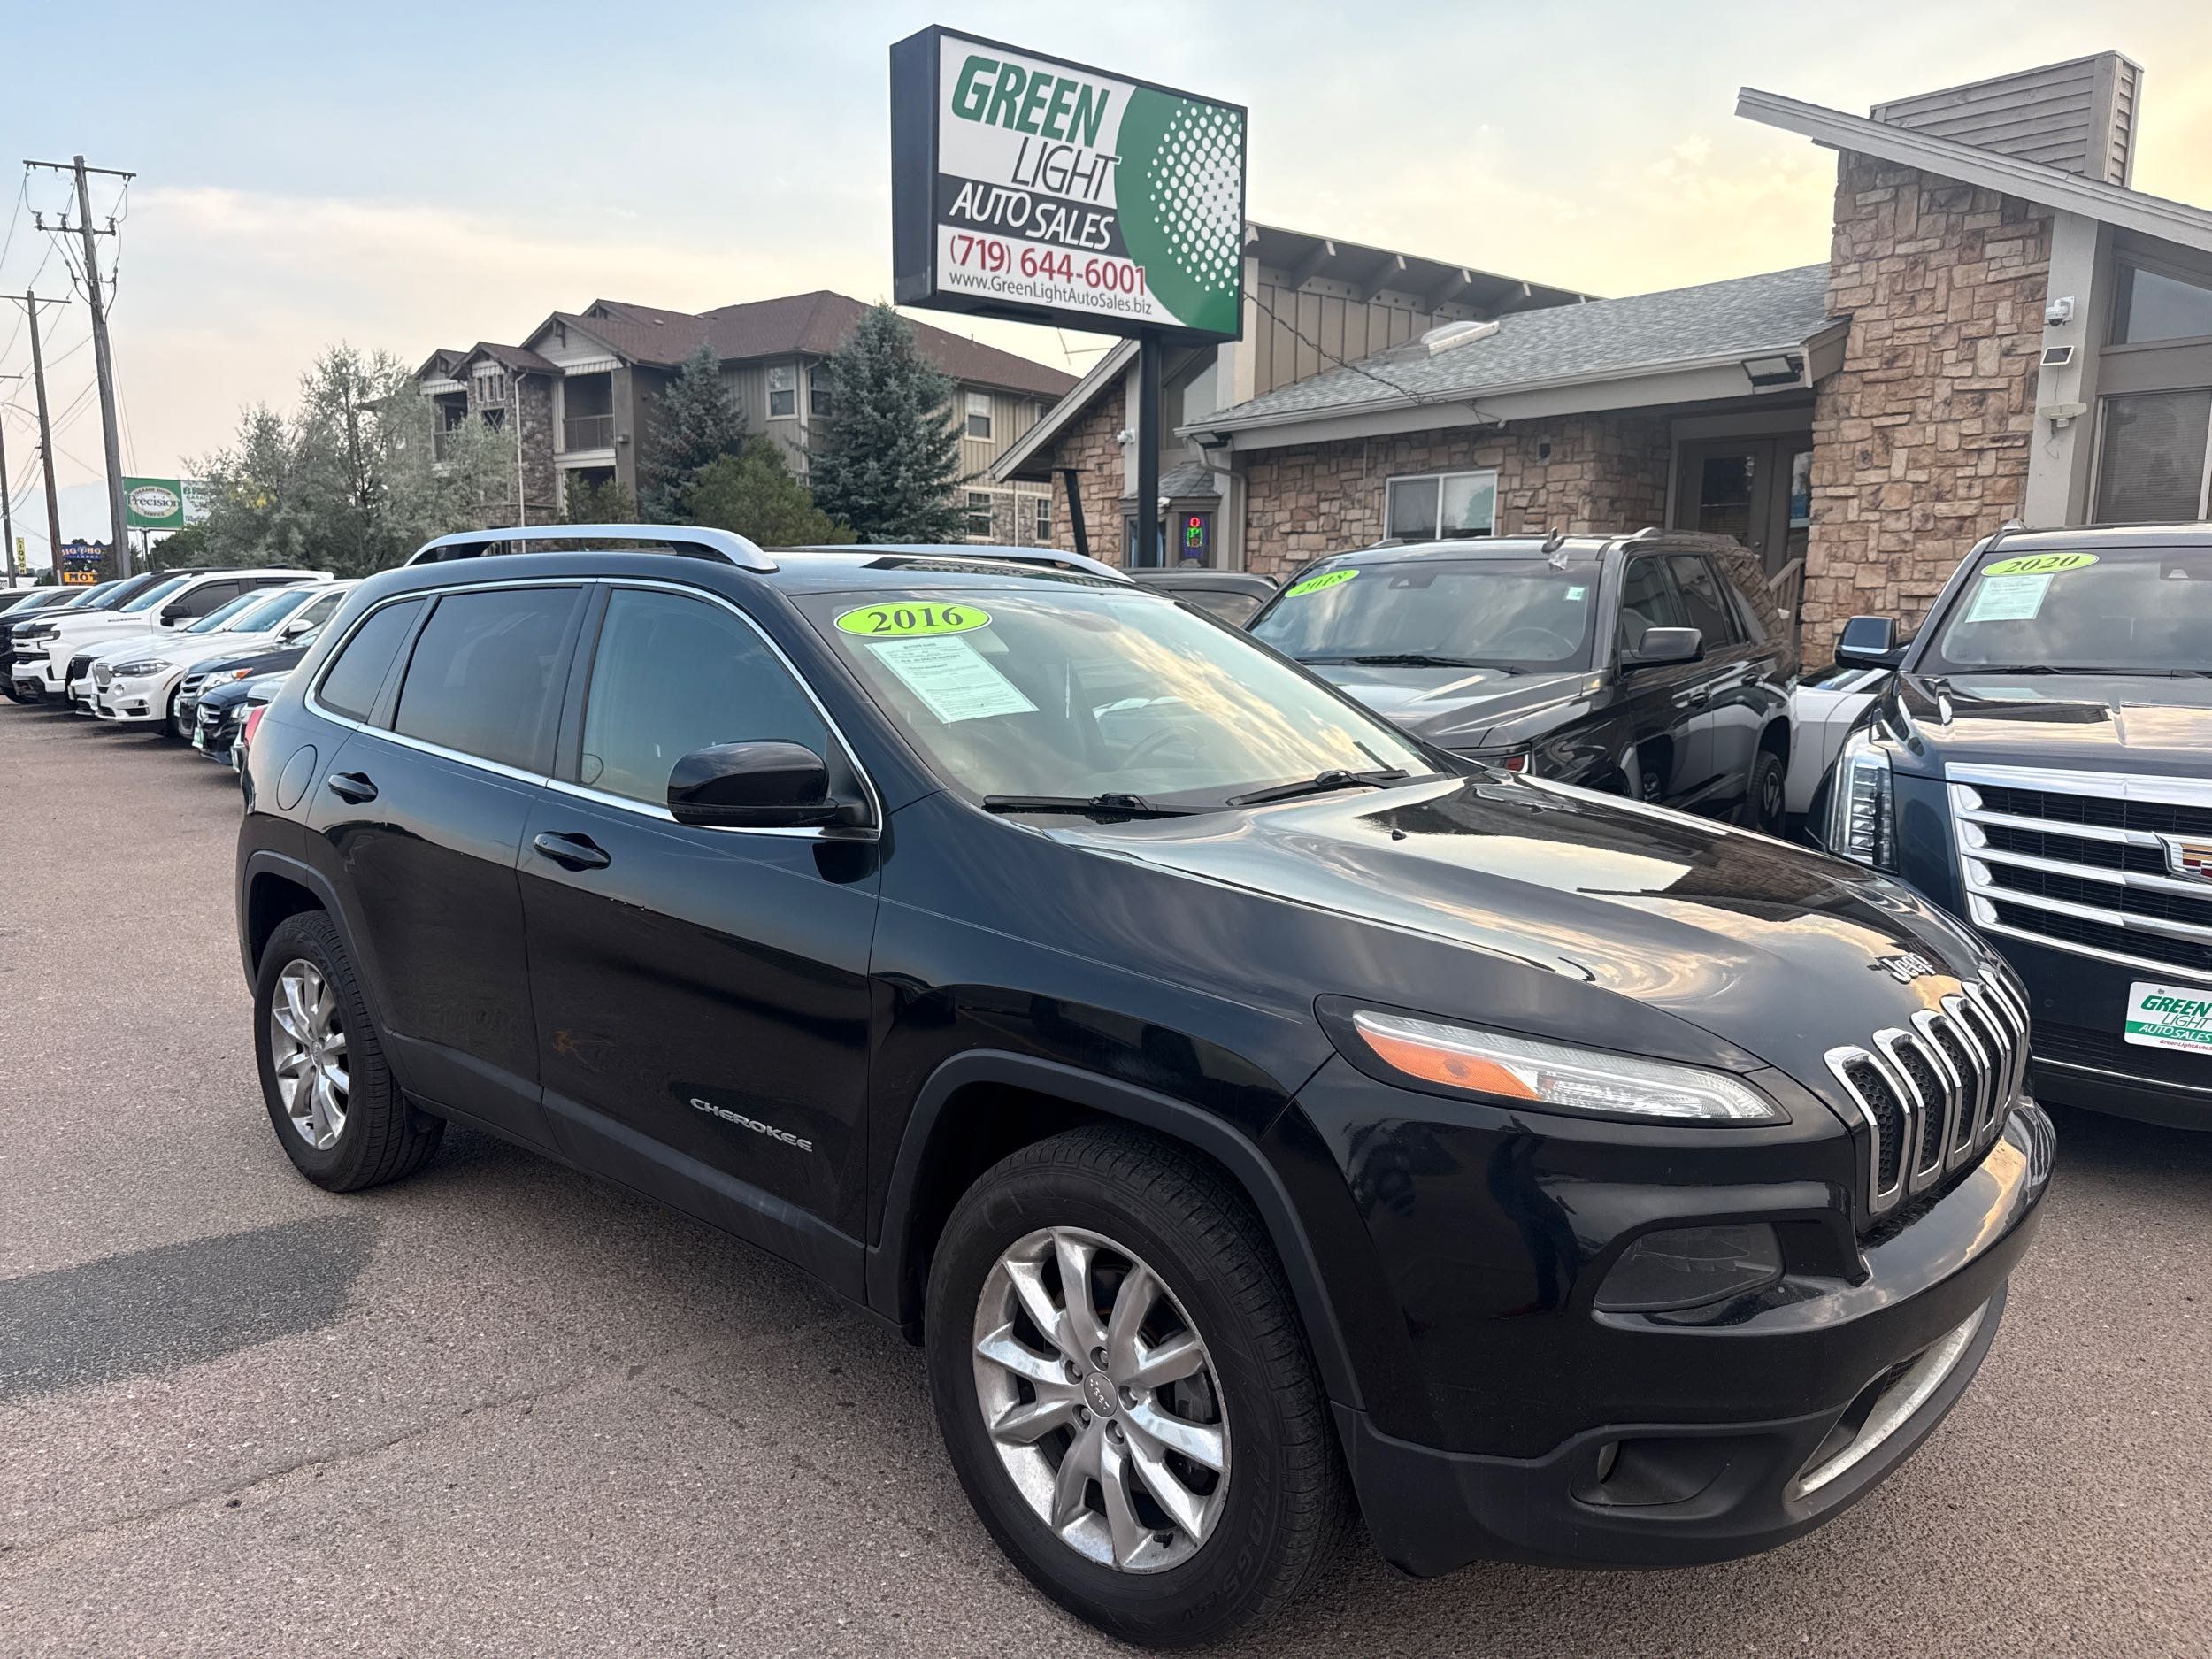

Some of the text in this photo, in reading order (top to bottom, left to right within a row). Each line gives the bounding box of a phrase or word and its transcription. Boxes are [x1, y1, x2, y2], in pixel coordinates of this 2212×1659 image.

[951, 54, 1110, 148] GREEN
[1011, 136, 1119, 201] LIGHT
[949, 181, 1115, 250] AUTO SALES
[950, 234, 1146, 296] (719) 644-6001
[949, 271, 1153, 315] www.GreenLightAutoSales.biz
[127, 495, 181, 507] Precision
[2000, 555, 2081, 573] 2020
[1295, 572, 1348, 595] 2018
[867, 606, 964, 633] 2016
[1881, 952, 1936, 982] Jeep
[2140, 995, 2212, 1018] GREEN
[2139, 1025, 2211, 1042] AUTO SALES
[2162, 1013, 2212, 1029] LIGHT
[690, 1098, 813, 1152] CHEROKEE
